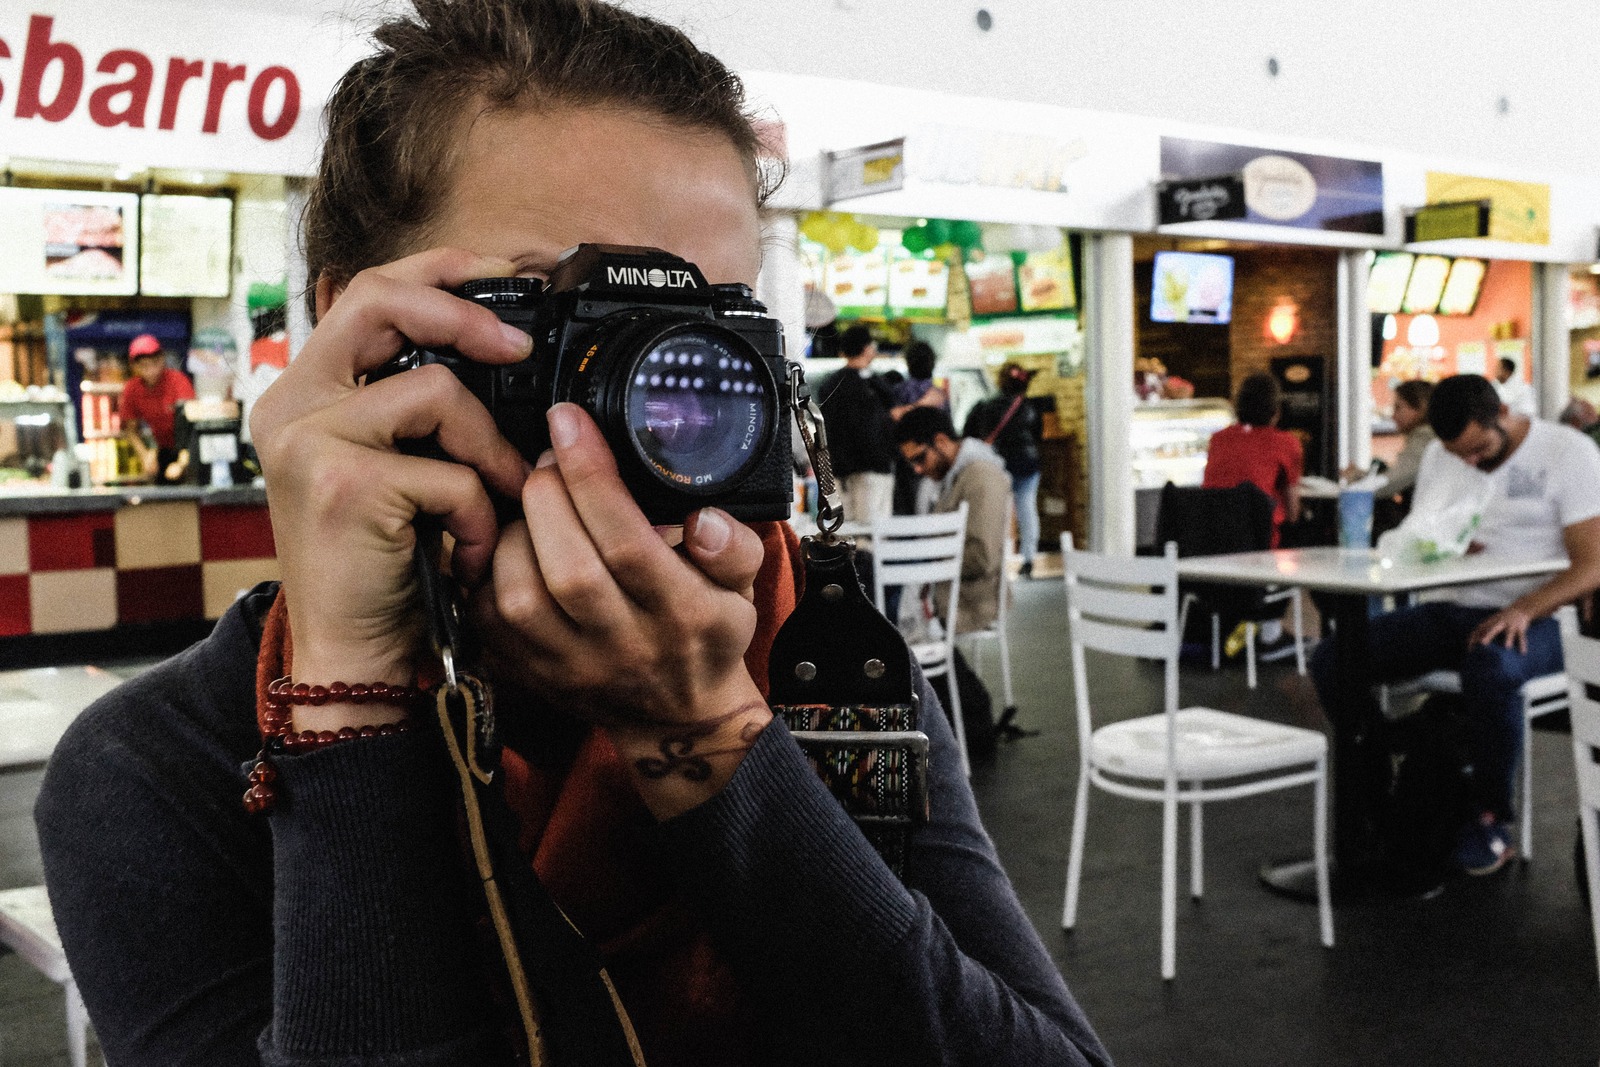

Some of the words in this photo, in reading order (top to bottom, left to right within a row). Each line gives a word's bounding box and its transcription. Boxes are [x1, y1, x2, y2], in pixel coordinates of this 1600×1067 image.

[0, 14, 302, 141] barro
[607, 266, 698, 289] MINOLTA
[740, 403, 757, 450] MINOLTA
[695, 473, 713, 484] MD
